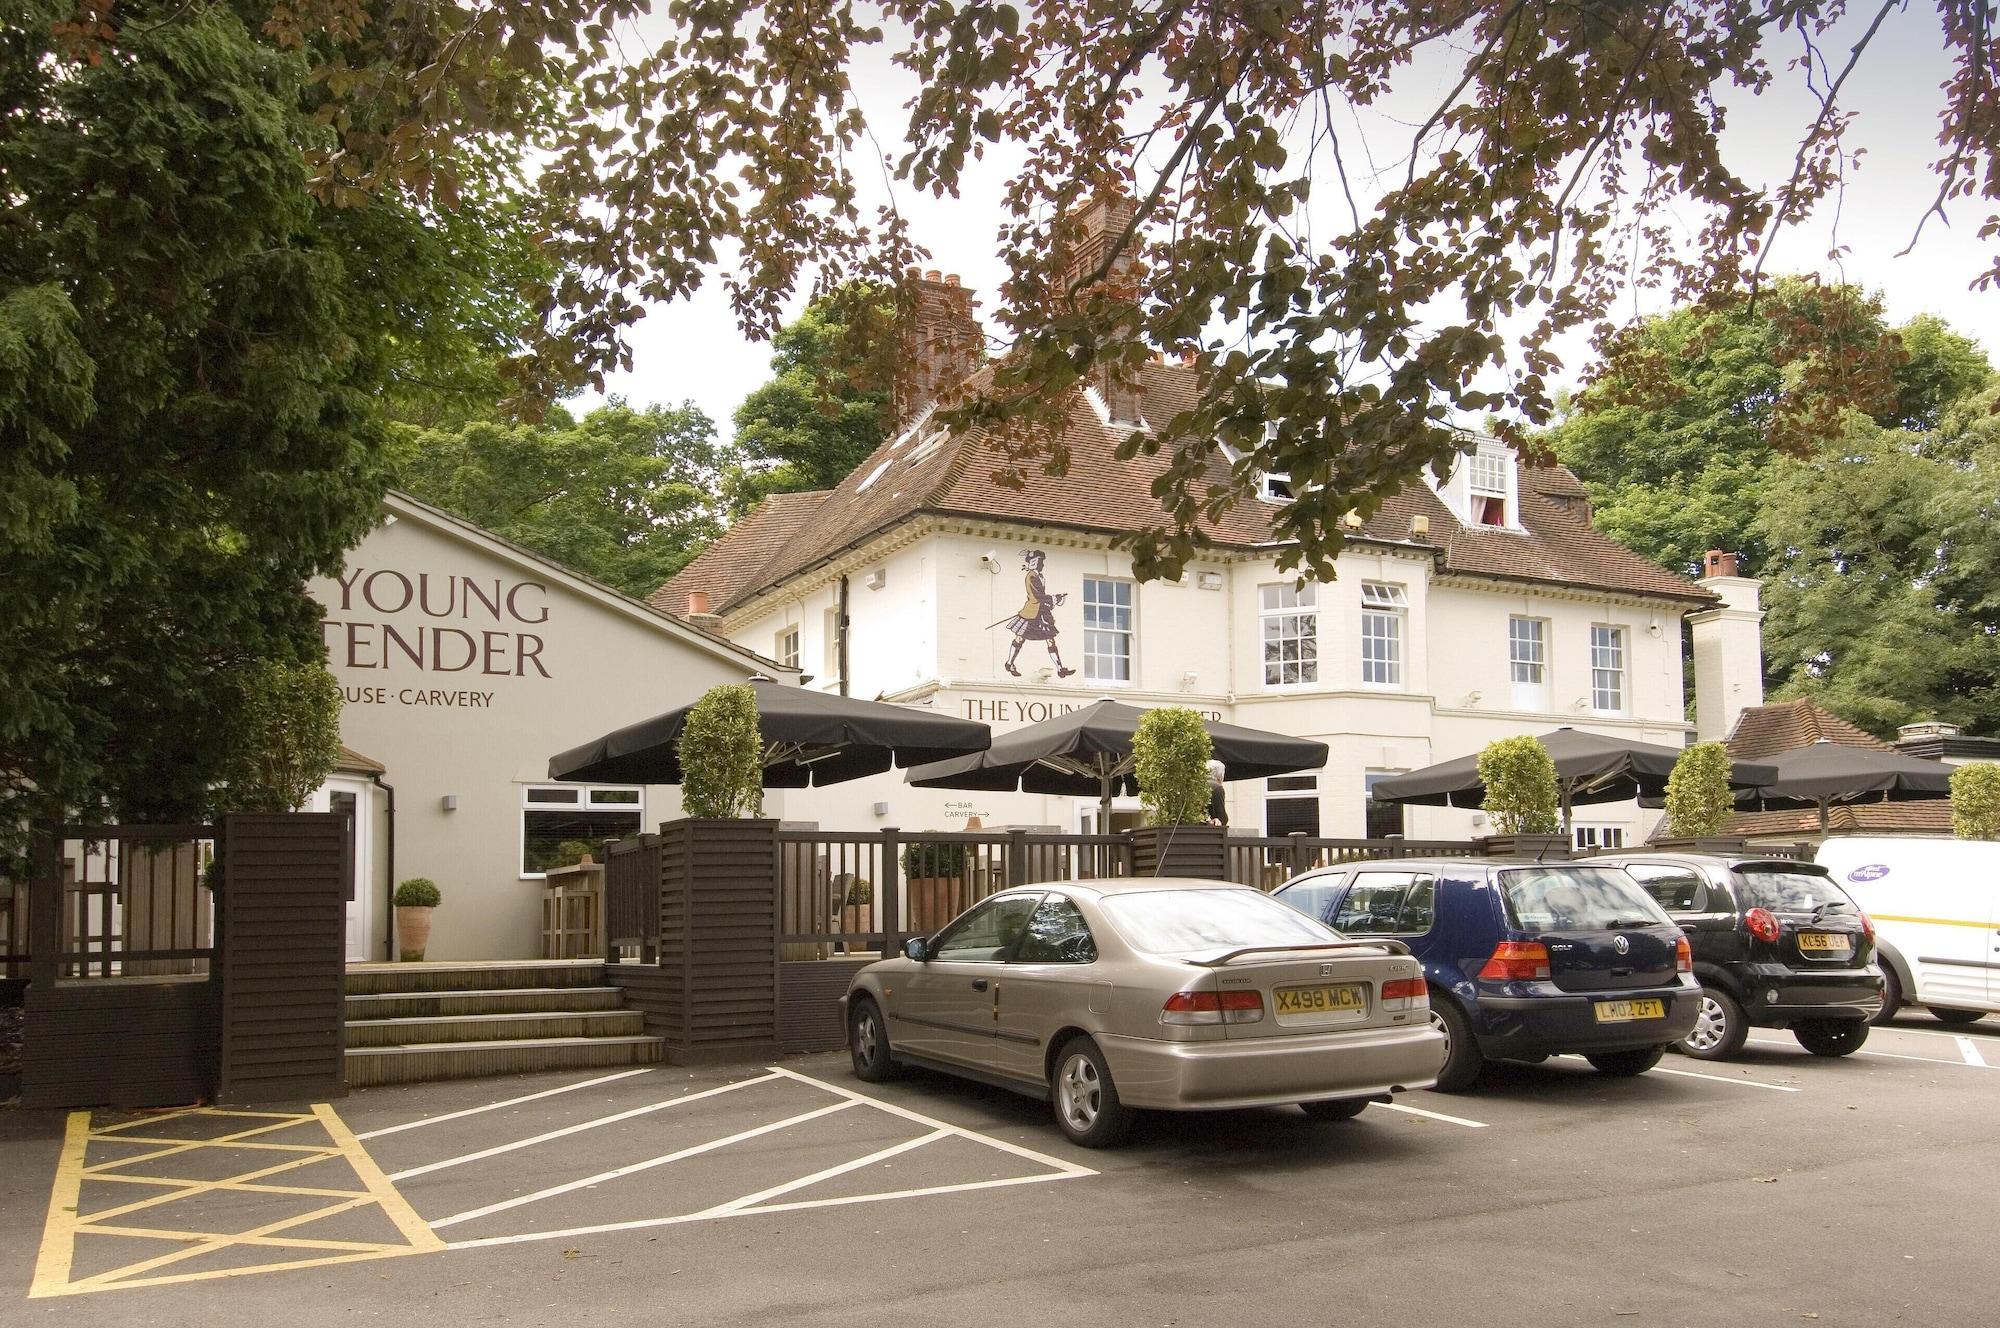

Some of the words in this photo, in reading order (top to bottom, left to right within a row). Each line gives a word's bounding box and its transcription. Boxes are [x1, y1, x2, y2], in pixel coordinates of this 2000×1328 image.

[336, 567, 549, 624] YOUNG
[399, 688, 494, 708] CARVERY
[962, 698, 1010, 721] THE
[944, 810, 978, 818] CARVERY
[957, 801, 973, 809] BAR
[1276, 990, 1325, 1010] X498
[1635, 1001, 1657, 1016] ZFT
